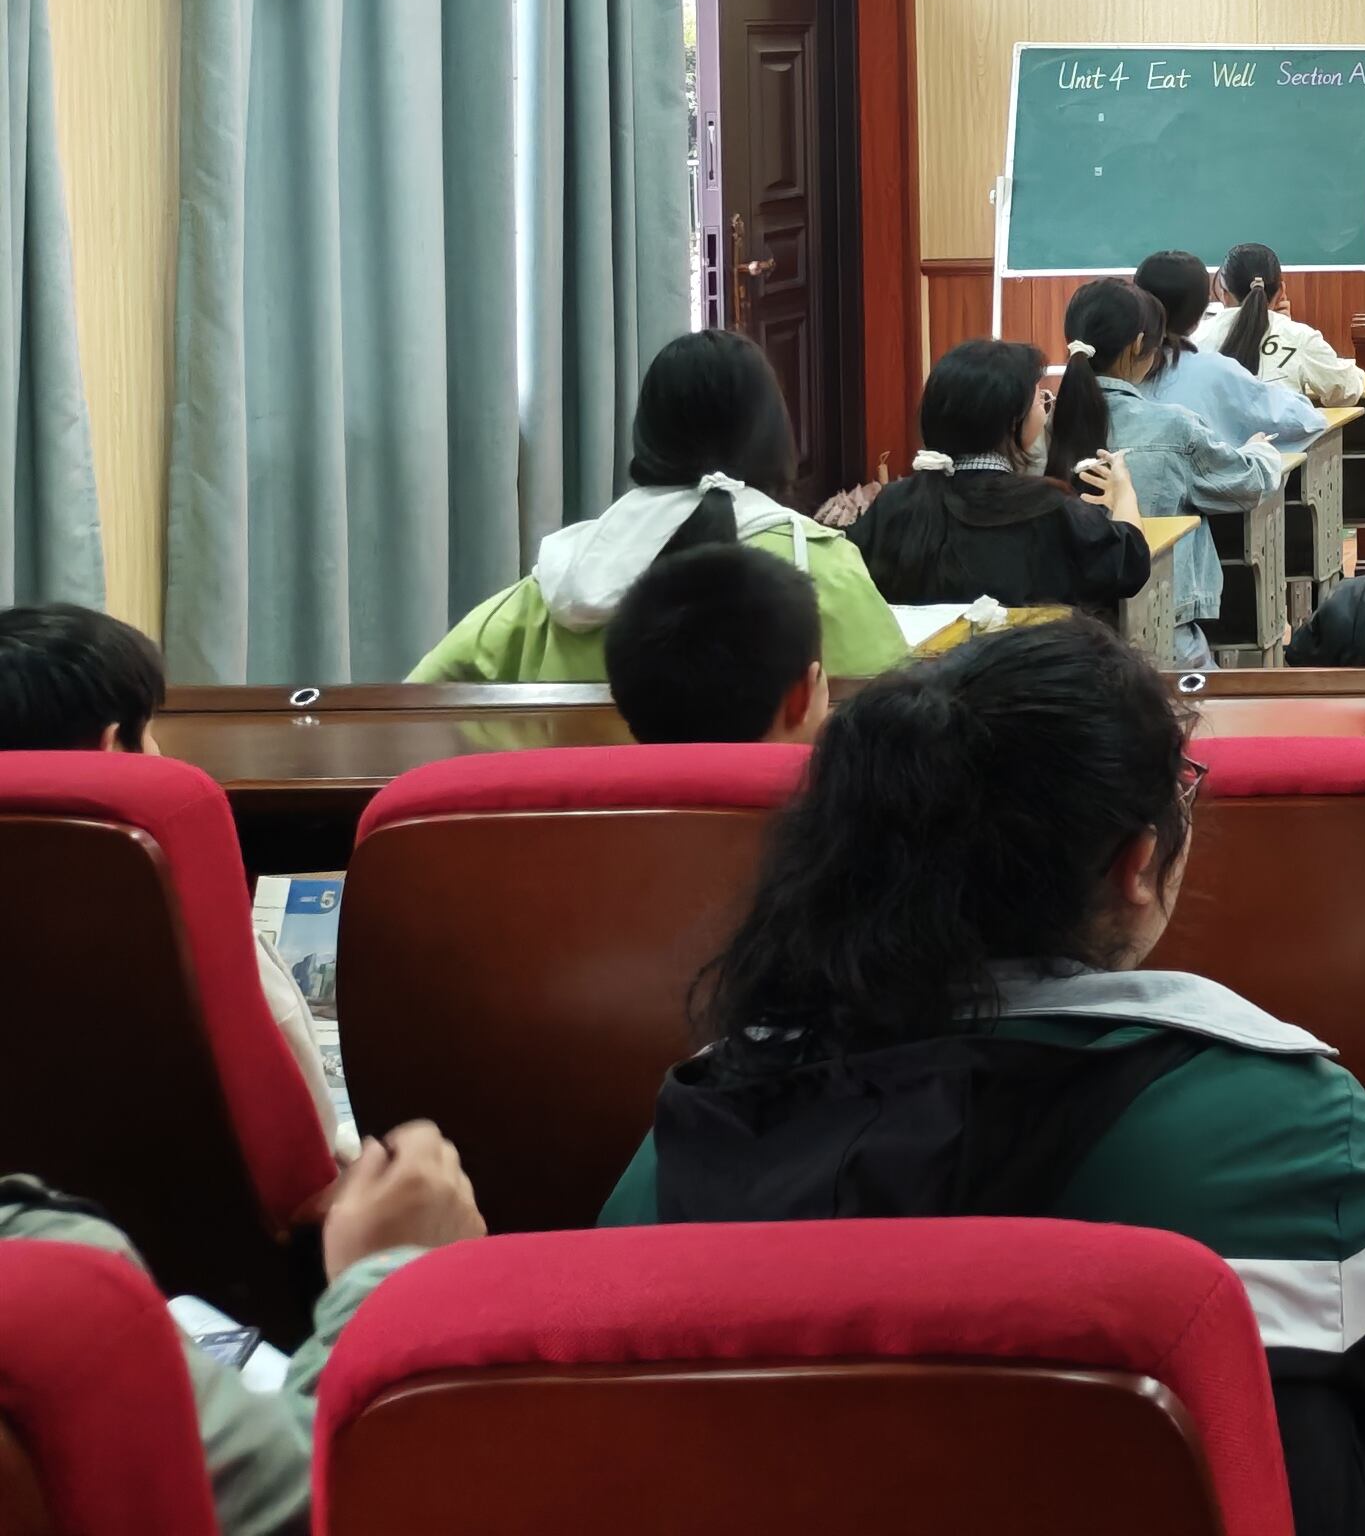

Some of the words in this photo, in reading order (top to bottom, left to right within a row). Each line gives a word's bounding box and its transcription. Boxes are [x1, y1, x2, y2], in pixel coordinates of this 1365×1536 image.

[1058, 61, 1105, 90] Unit
[1108, 61, 1130, 91] 4
[1146, 61, 1192, 90] Eat
[1212, 61, 1257, 88] Well
[1276, 60, 1344, 87] Section
[1261, 334, 1297, 368] 67
